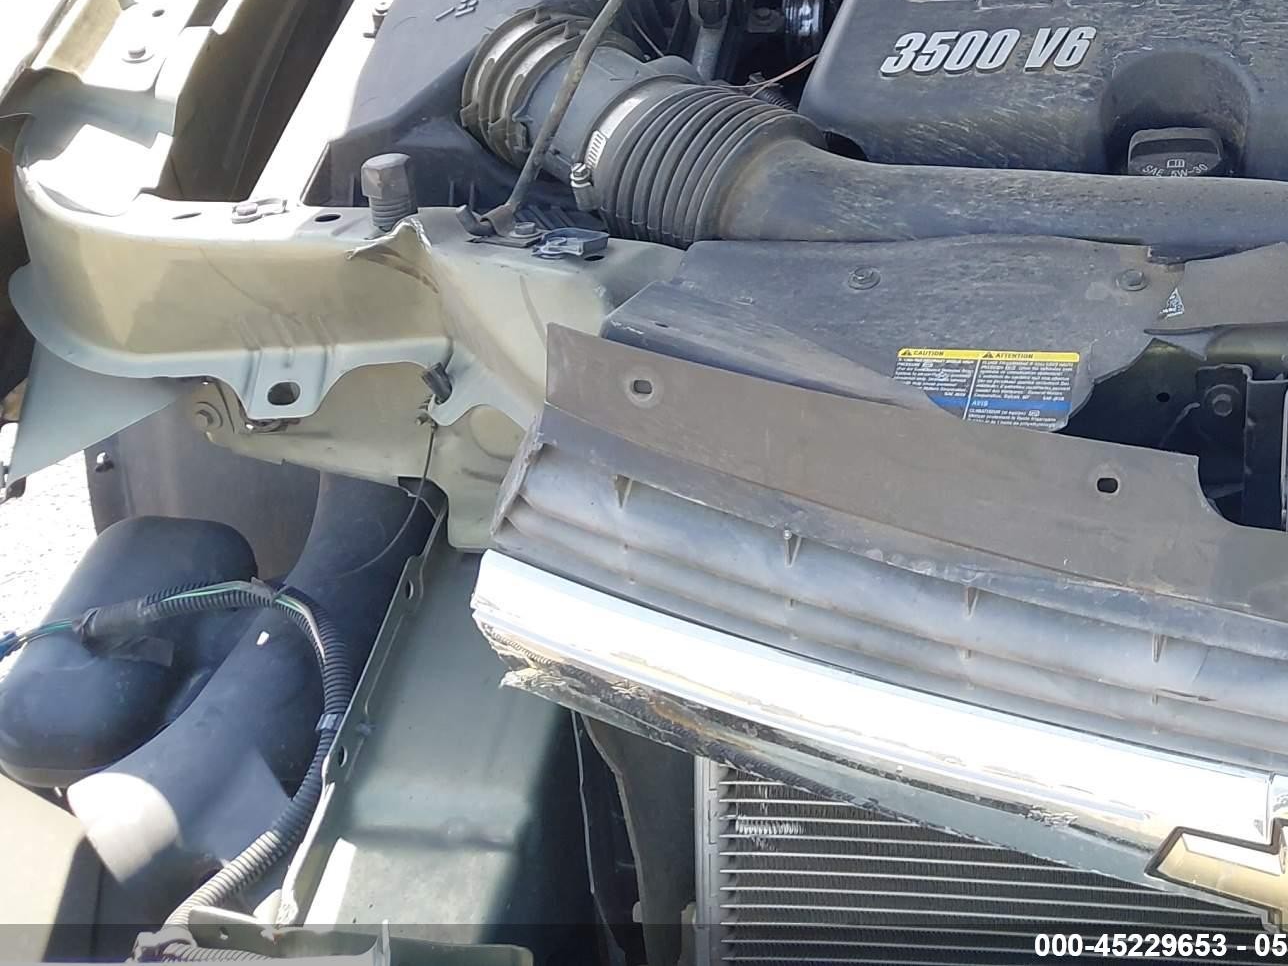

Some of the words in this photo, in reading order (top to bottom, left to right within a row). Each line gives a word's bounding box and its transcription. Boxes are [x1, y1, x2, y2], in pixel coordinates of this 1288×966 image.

[879, 28, 1020, 78] 3500
[1024, 25, 1097, 72] V6
[1142, 164, 1164, 177] SAE
[1170, 164, 1208, 177] 5W-30
